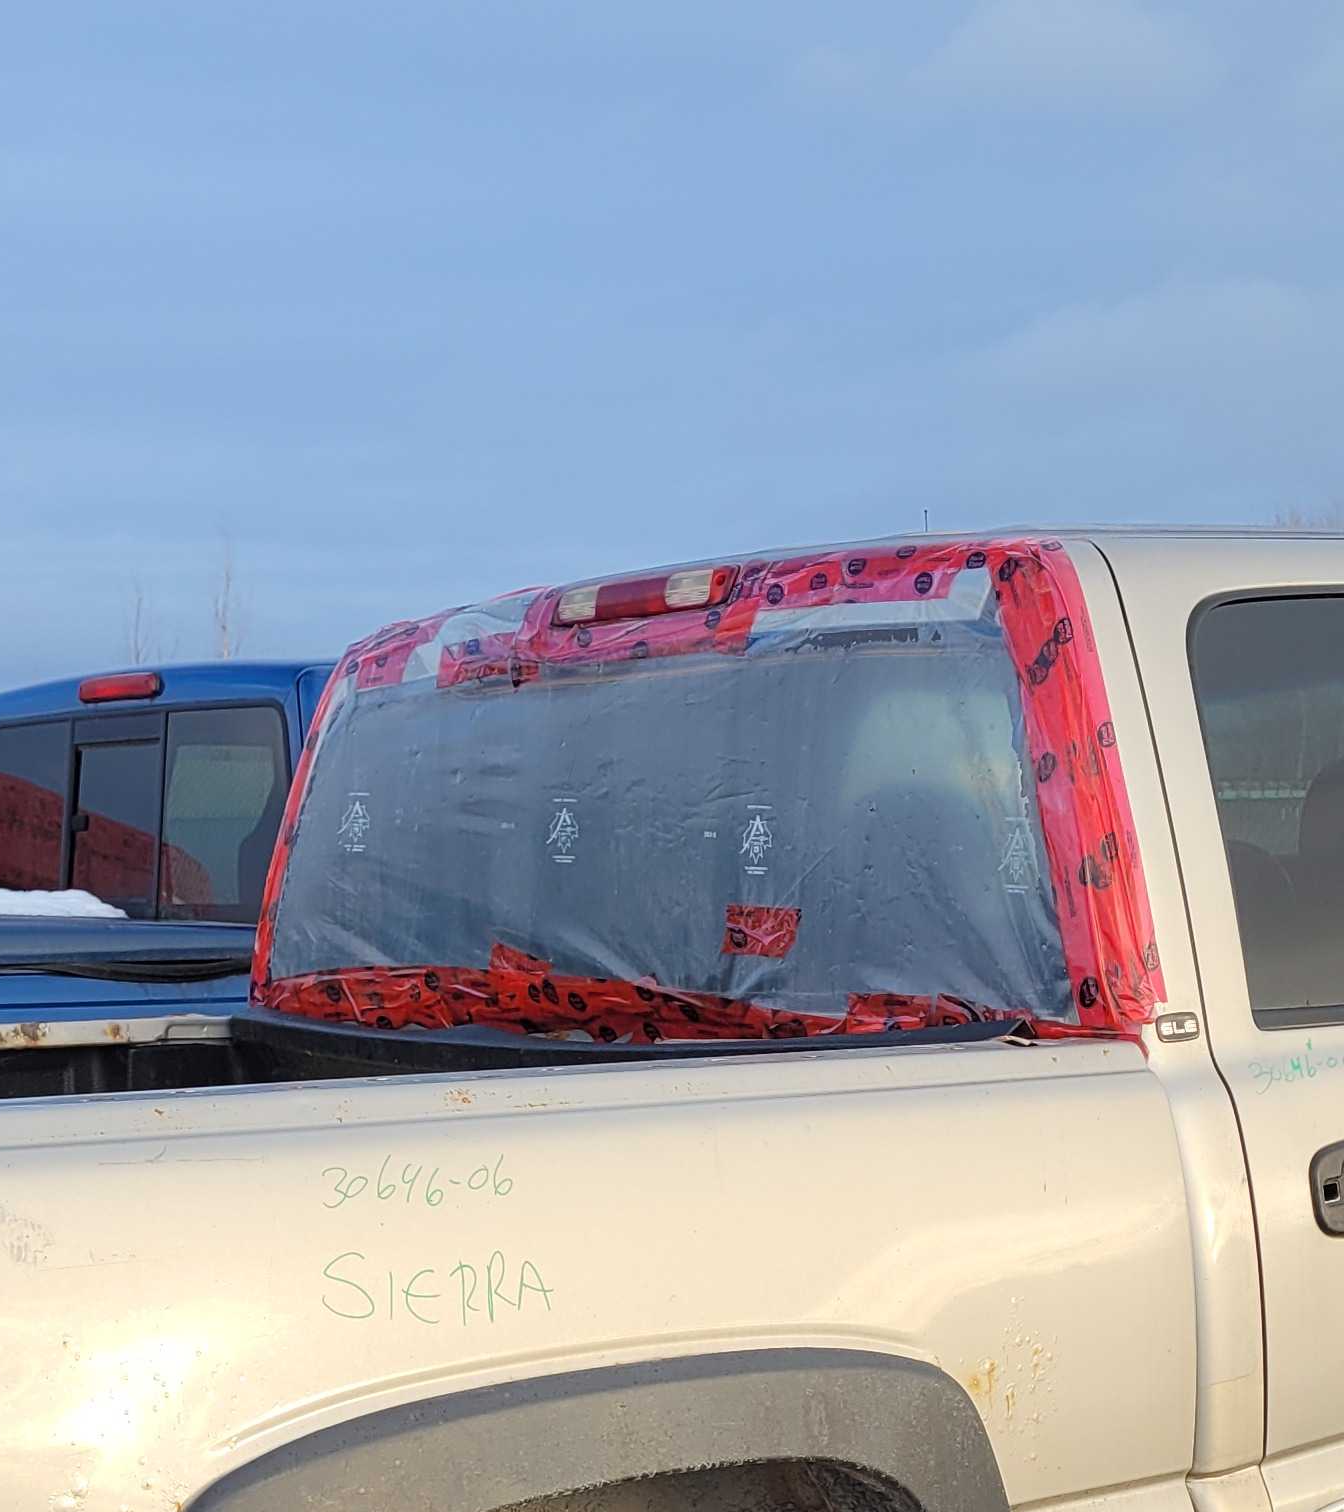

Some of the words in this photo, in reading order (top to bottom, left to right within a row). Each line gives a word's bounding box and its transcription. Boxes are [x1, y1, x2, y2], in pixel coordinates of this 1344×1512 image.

[1160, 1019, 1198, 1036] SLE
[321, 1153, 513, 1209] 30646-06
[321, 1249, 555, 1327] SIERRA
